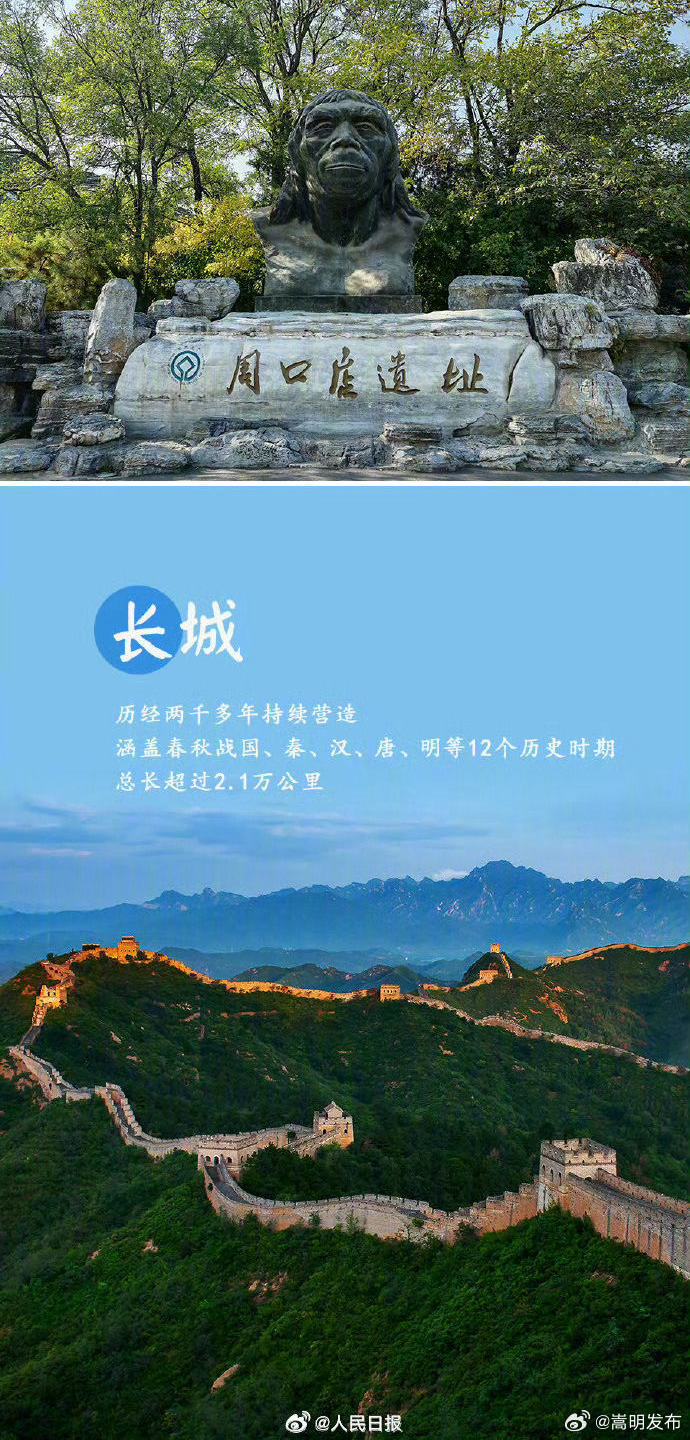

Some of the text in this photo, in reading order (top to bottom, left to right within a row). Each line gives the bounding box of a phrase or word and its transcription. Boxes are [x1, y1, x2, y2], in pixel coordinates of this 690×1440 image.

[226, 346, 489, 400] 周口店遗址
